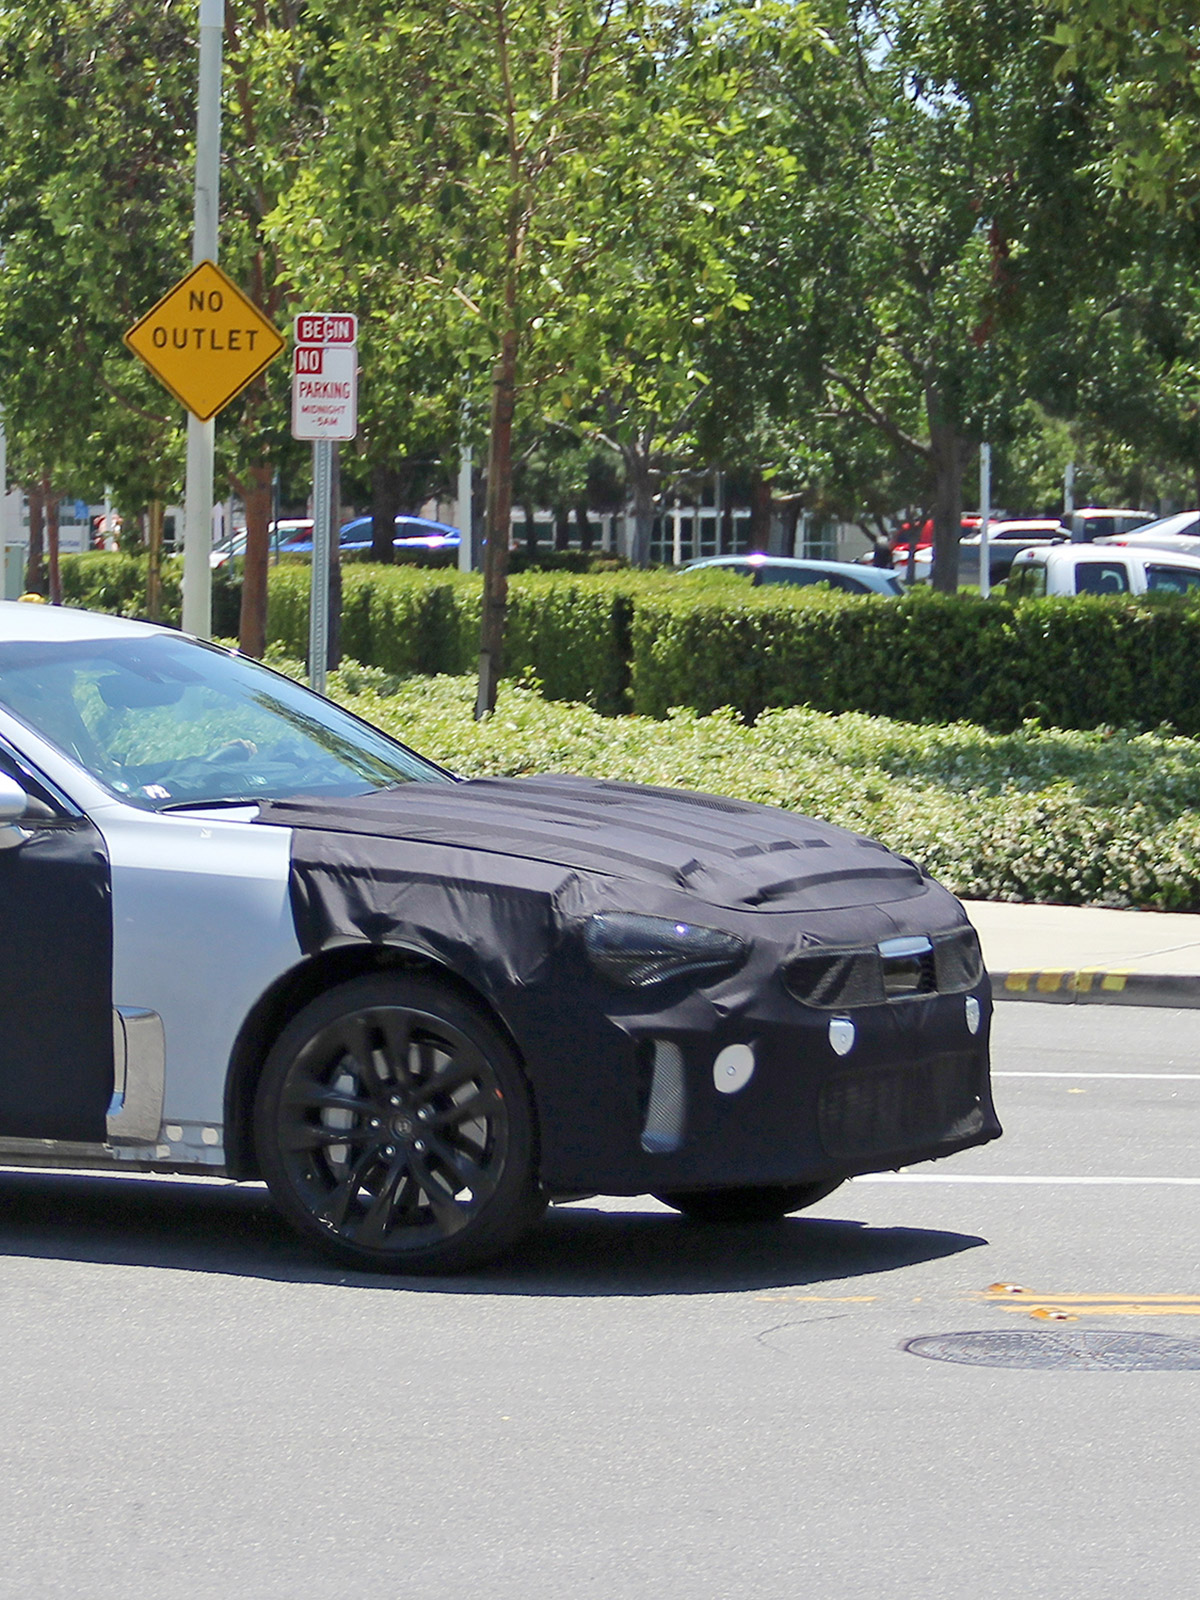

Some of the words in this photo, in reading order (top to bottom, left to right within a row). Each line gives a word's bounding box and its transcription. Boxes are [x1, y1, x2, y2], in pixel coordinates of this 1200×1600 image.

[189, 290, 223, 312] NO
[152, 326, 259, 351] OUTLET
[302, 320, 349, 339] BEGIN
[298, 350, 320, 371] NO
[299, 381, 350, 399] PARKING
[301, 404, 346, 414] MIDNIGHT
